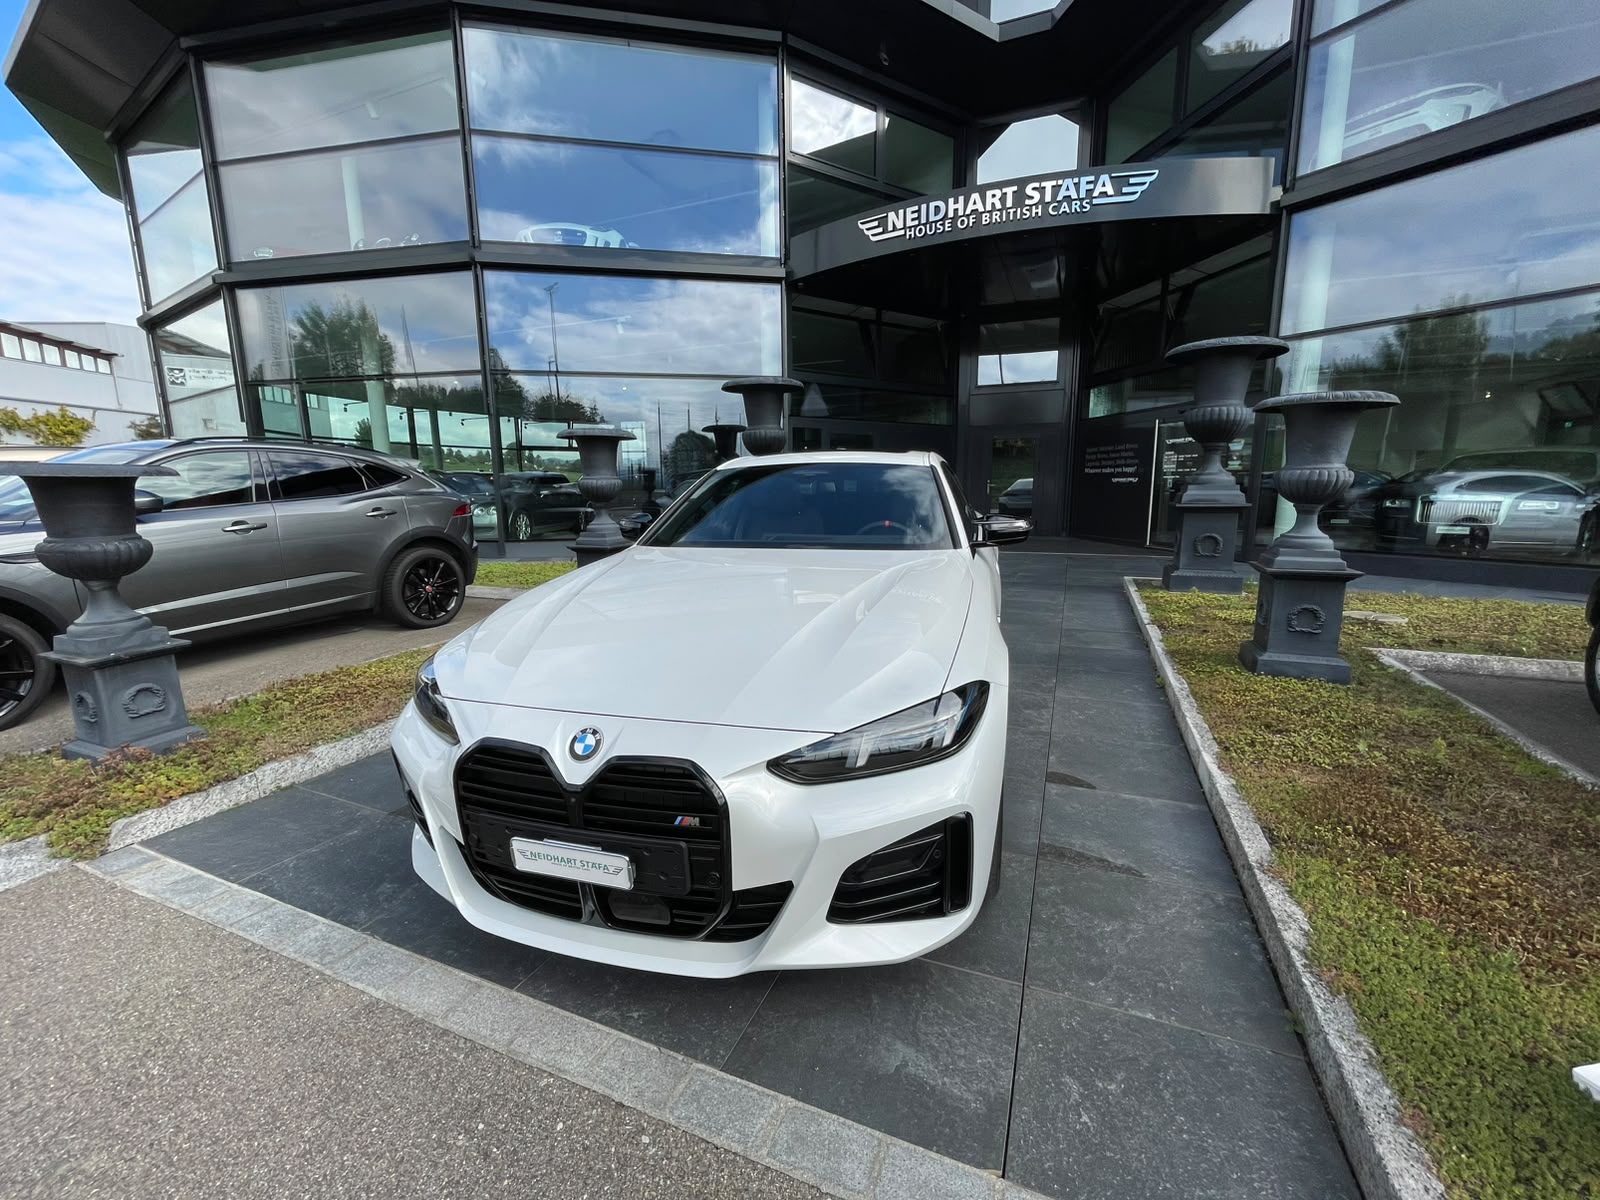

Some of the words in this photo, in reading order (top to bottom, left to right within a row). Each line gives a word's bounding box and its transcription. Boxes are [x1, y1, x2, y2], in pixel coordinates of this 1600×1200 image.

[887, 186, 1017, 231] NEIDHART
[1025, 174, 1114, 205] STÄFA
[906, 220, 951, 239] HOUSE
[957, 215, 976, 229] OF
[982, 204, 1042, 225] BRITISH
[1049, 200, 1091, 216] CARS
[576, 728, 601, 741] BMW
[529, 851, 578, 866] NEIDHART
[580, 859, 610, 872] STÄFA
